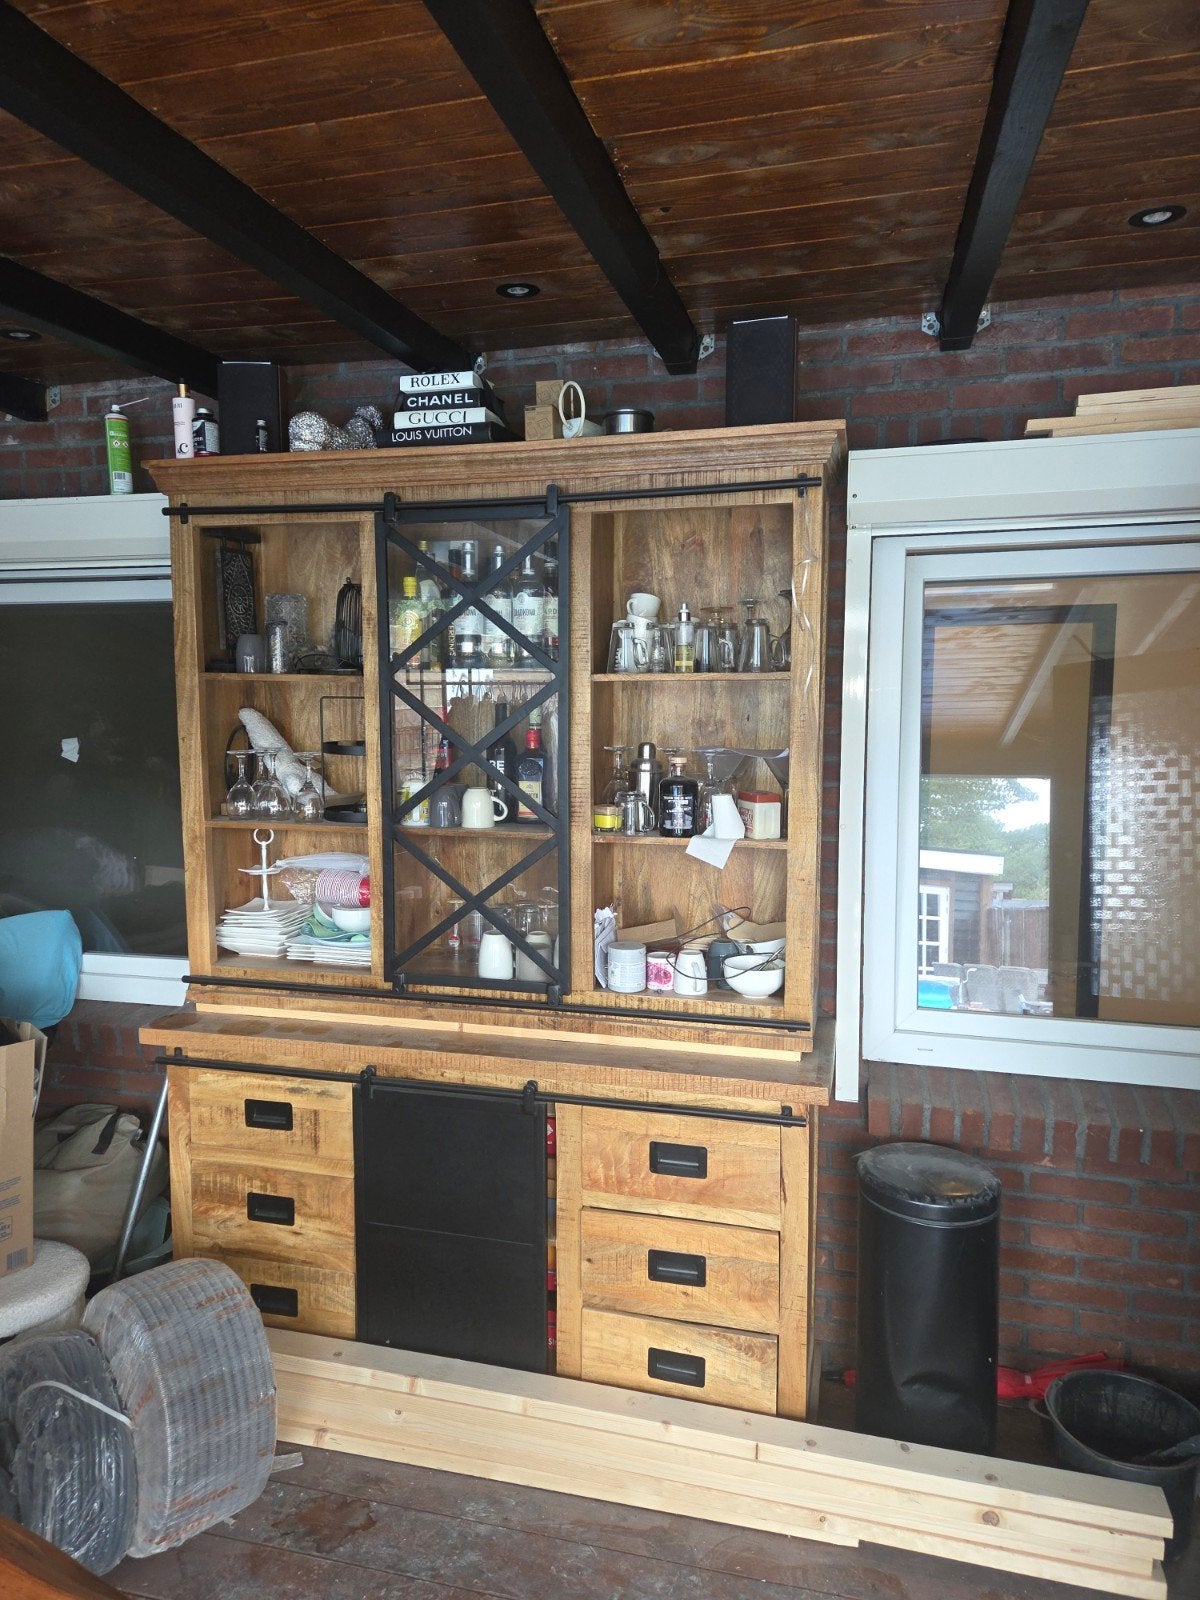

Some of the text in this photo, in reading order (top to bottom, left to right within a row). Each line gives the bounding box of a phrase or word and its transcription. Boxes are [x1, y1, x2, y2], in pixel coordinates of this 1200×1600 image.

[410, 373, 460, 388] ROLEX
[406, 393, 474, 408] CHANEL
[408, 410, 467, 425] GUCCI
[391, 426, 472, 442] LOUIS VUITTON
